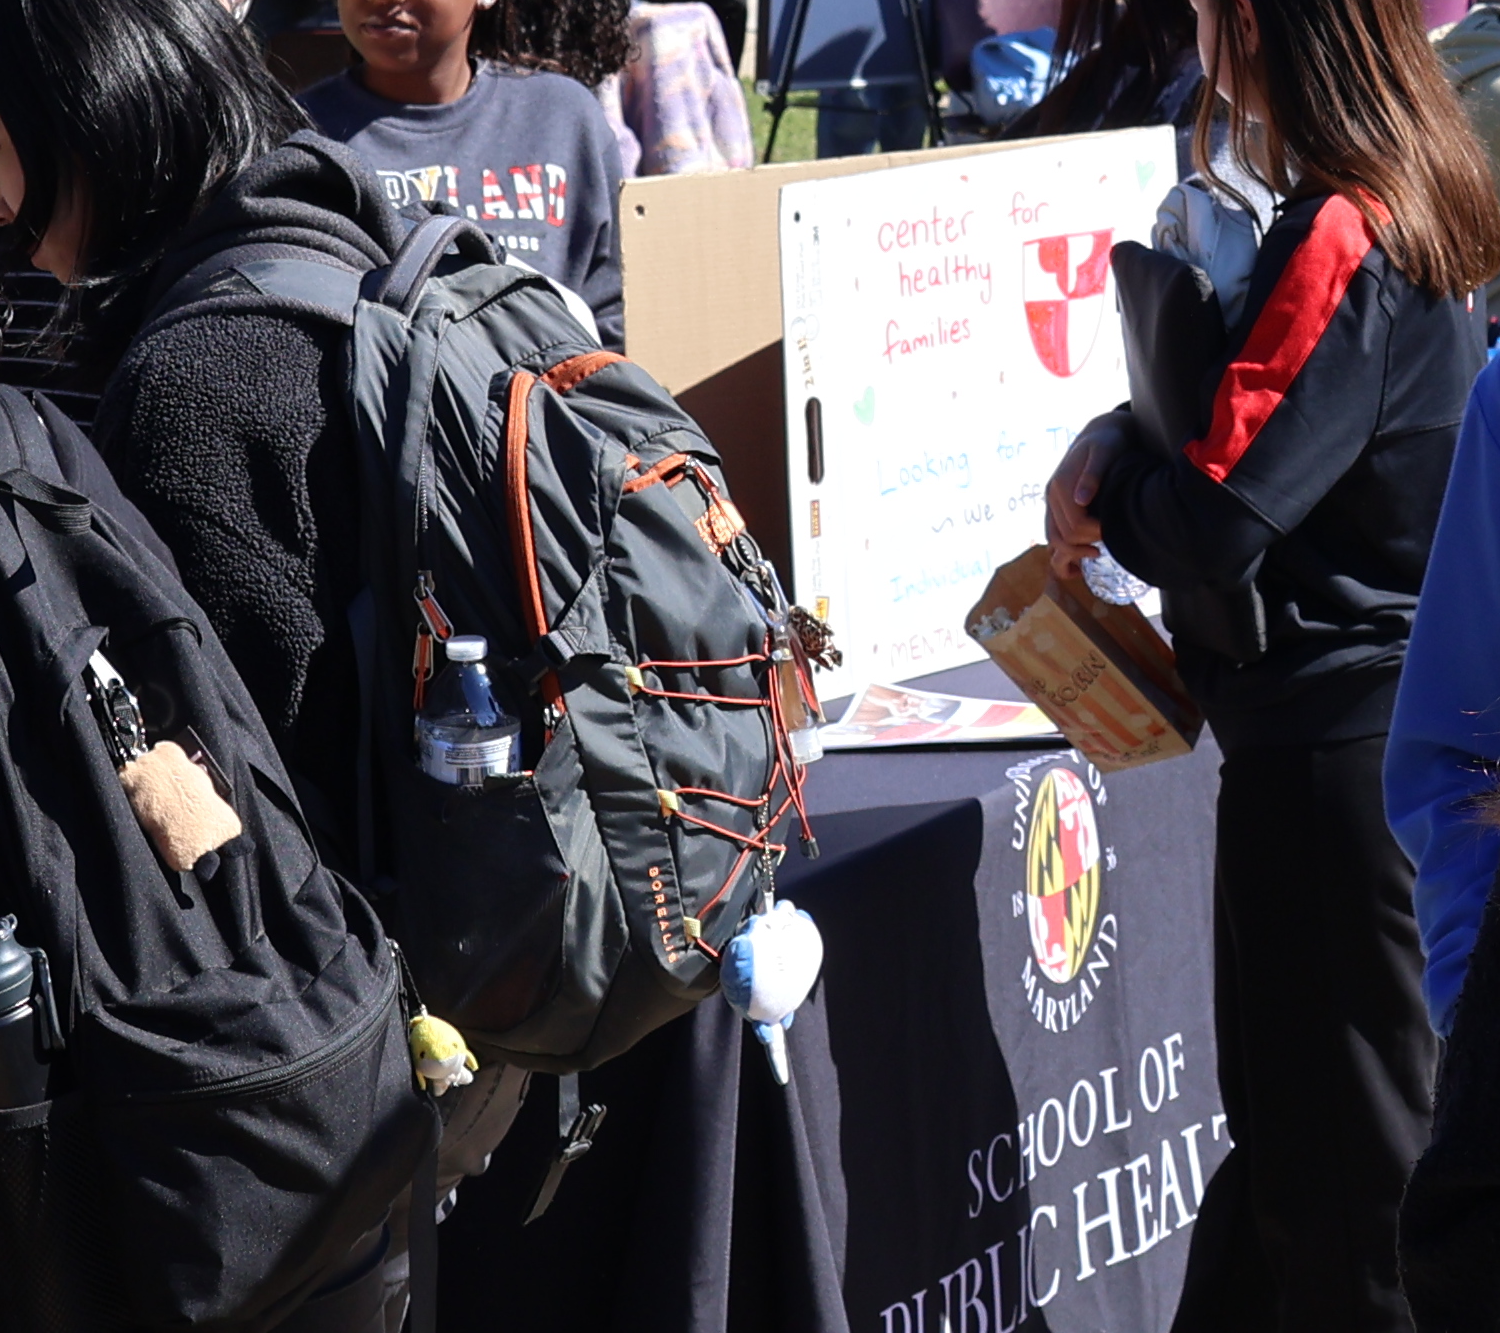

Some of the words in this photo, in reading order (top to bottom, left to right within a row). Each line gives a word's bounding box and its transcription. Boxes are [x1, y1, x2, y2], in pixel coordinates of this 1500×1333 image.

[878, 205, 974, 252] center
[1008, 191, 1049, 225] for
[898, 254, 992, 304] healthy
[882, 317, 971, 364] families
[876, 450, 973, 496] Looking
[996, 430, 1027, 459] for
[890, 627, 967, 668] MENTAL
[1020, 912, 1118, 1034] MARYLAND
[967, 1066, 1132, 1219] SCHOOL
[1139, 1032, 1185, 1114] OF
